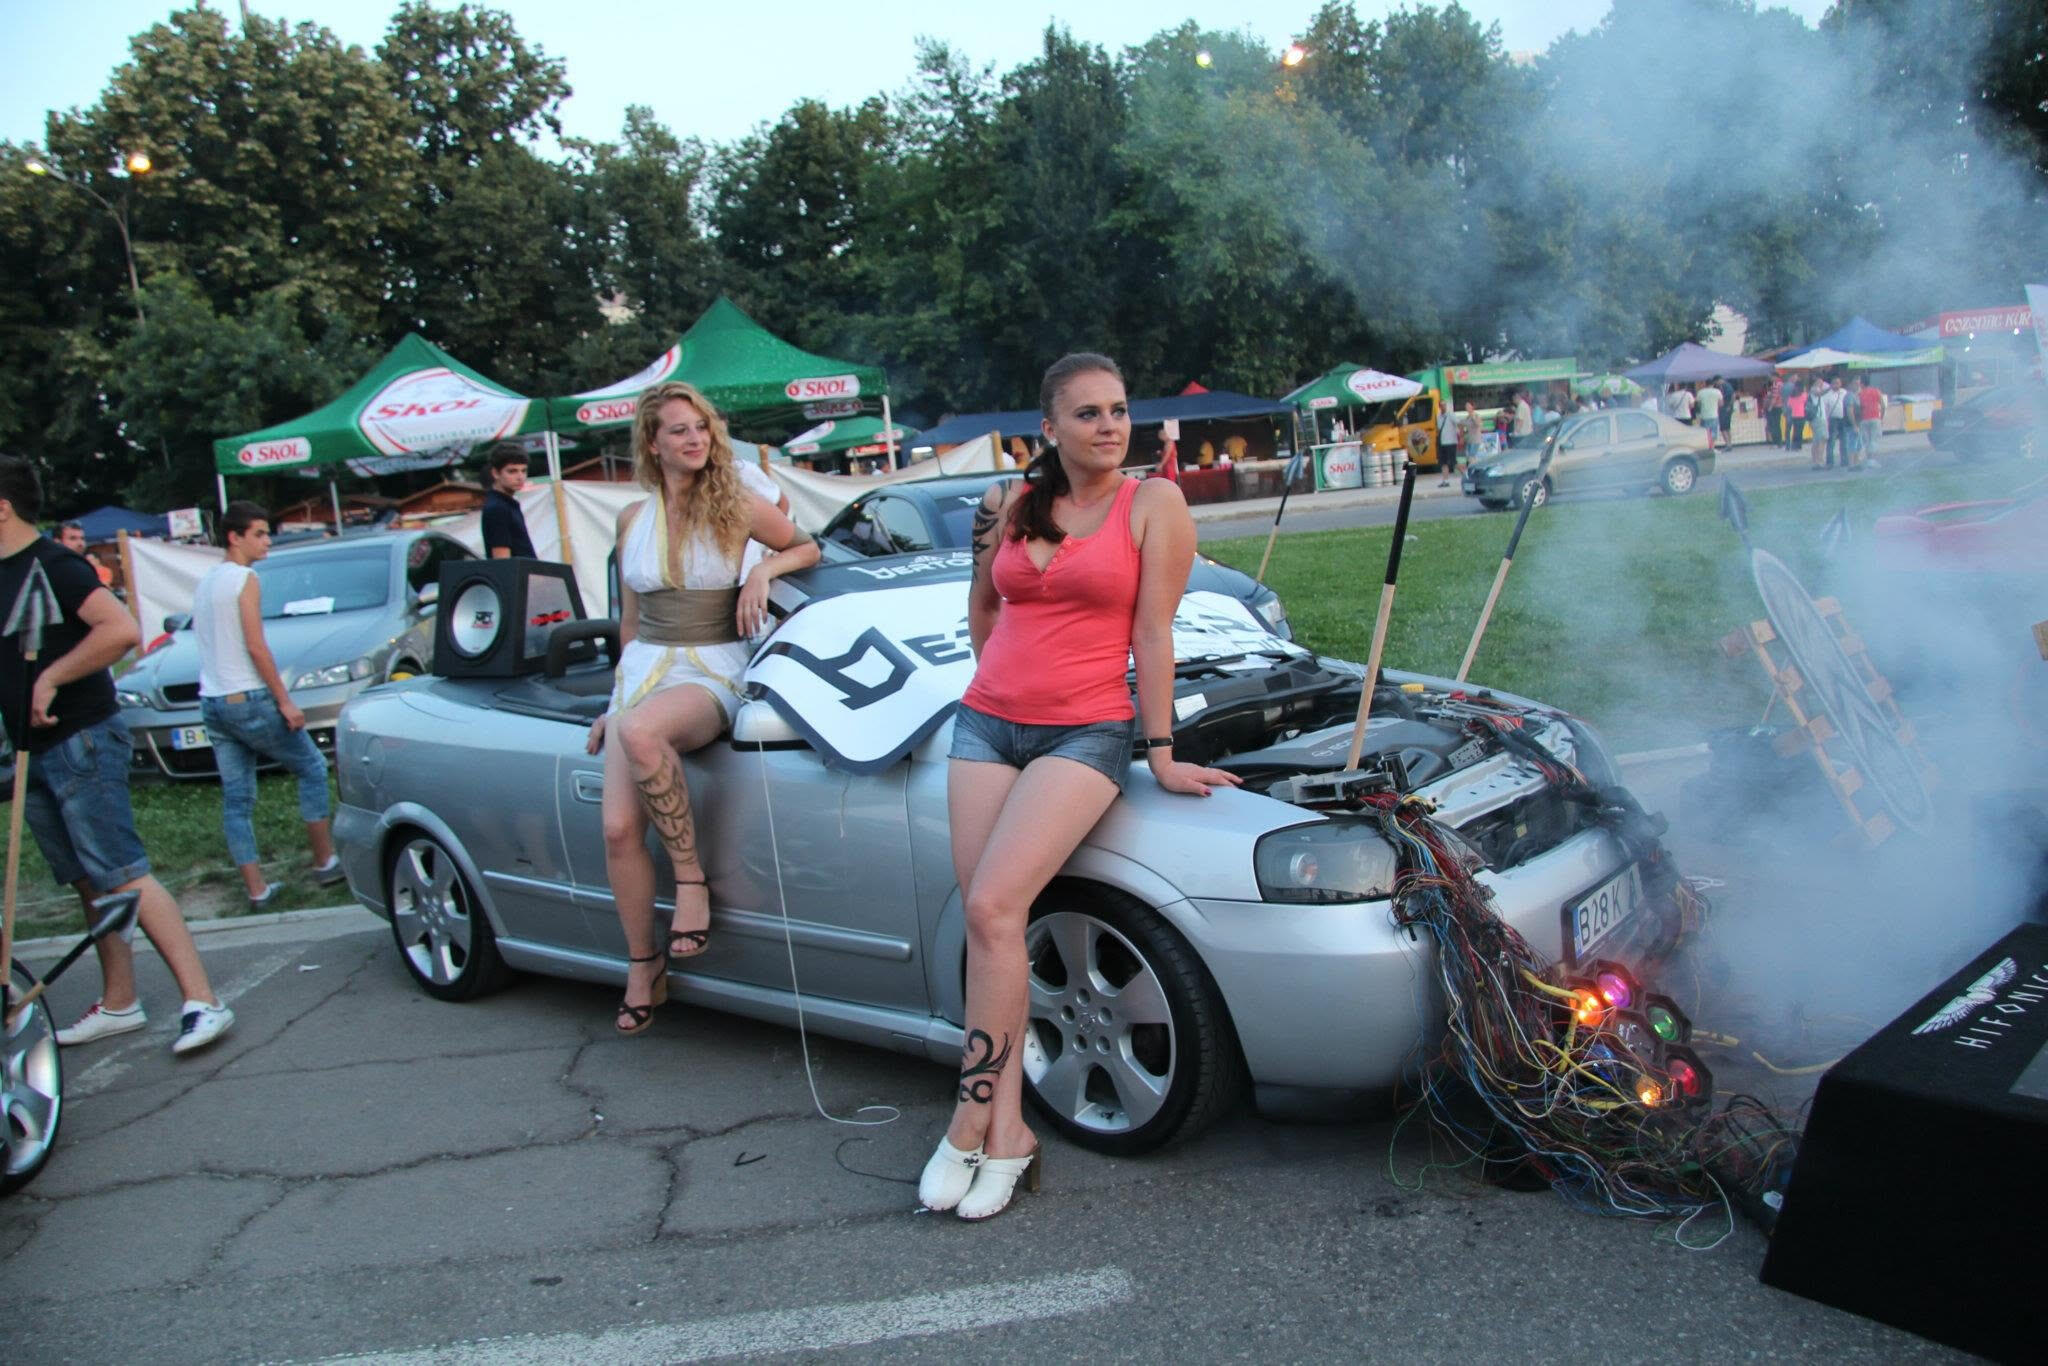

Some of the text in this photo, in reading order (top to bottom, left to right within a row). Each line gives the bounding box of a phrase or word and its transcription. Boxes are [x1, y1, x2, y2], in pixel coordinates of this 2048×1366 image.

[805, 380, 849, 396] SKOL
[368, 399, 487, 421] SKOL
[257, 442, 305, 462] SKOL
[1329, 462, 1356, 474] SKOL
